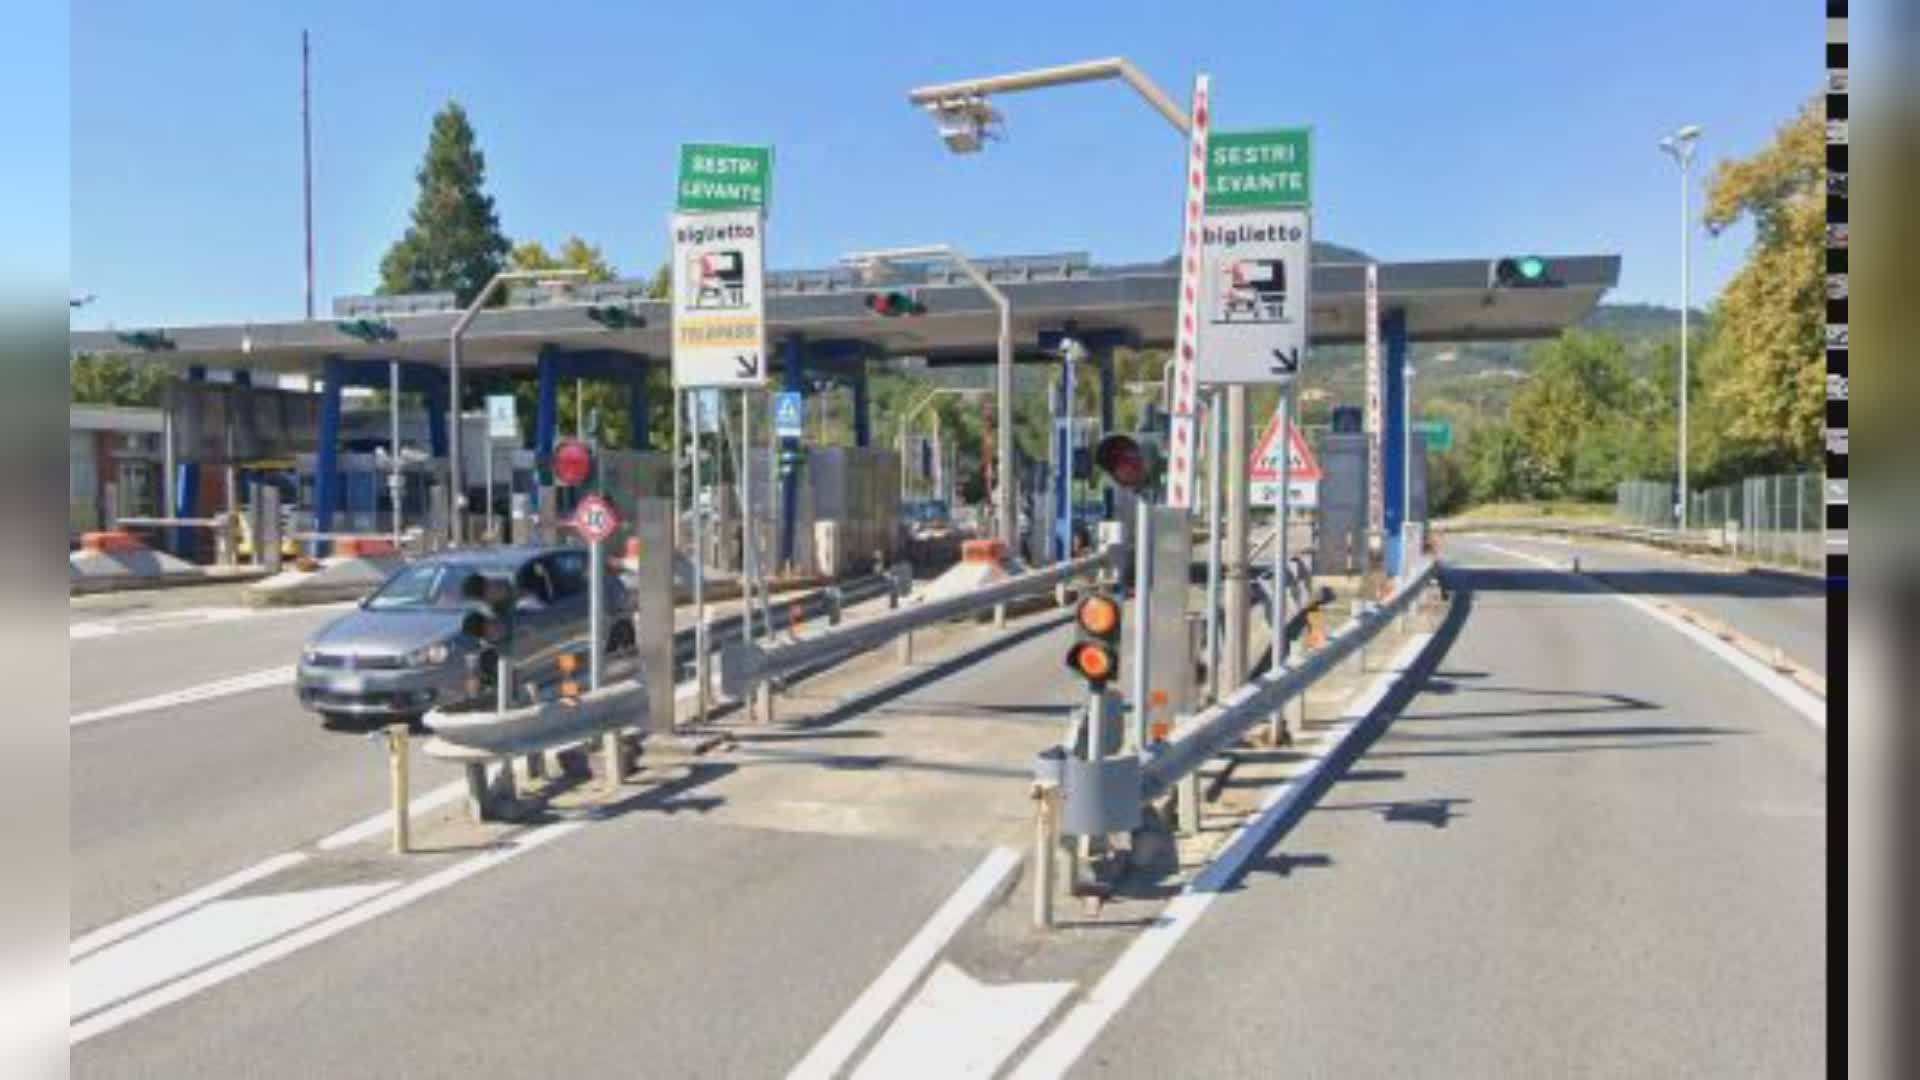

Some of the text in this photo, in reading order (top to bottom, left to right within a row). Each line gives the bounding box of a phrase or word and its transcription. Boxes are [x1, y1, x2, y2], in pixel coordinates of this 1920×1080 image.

[692, 155, 759, 174] SESTRI
[1214, 144, 1295, 166] SESTRI
[682, 181, 762, 202] LEVANTE
[677, 224, 755, 244] biglietto
[1203, 224, 1302, 246] biglietto
